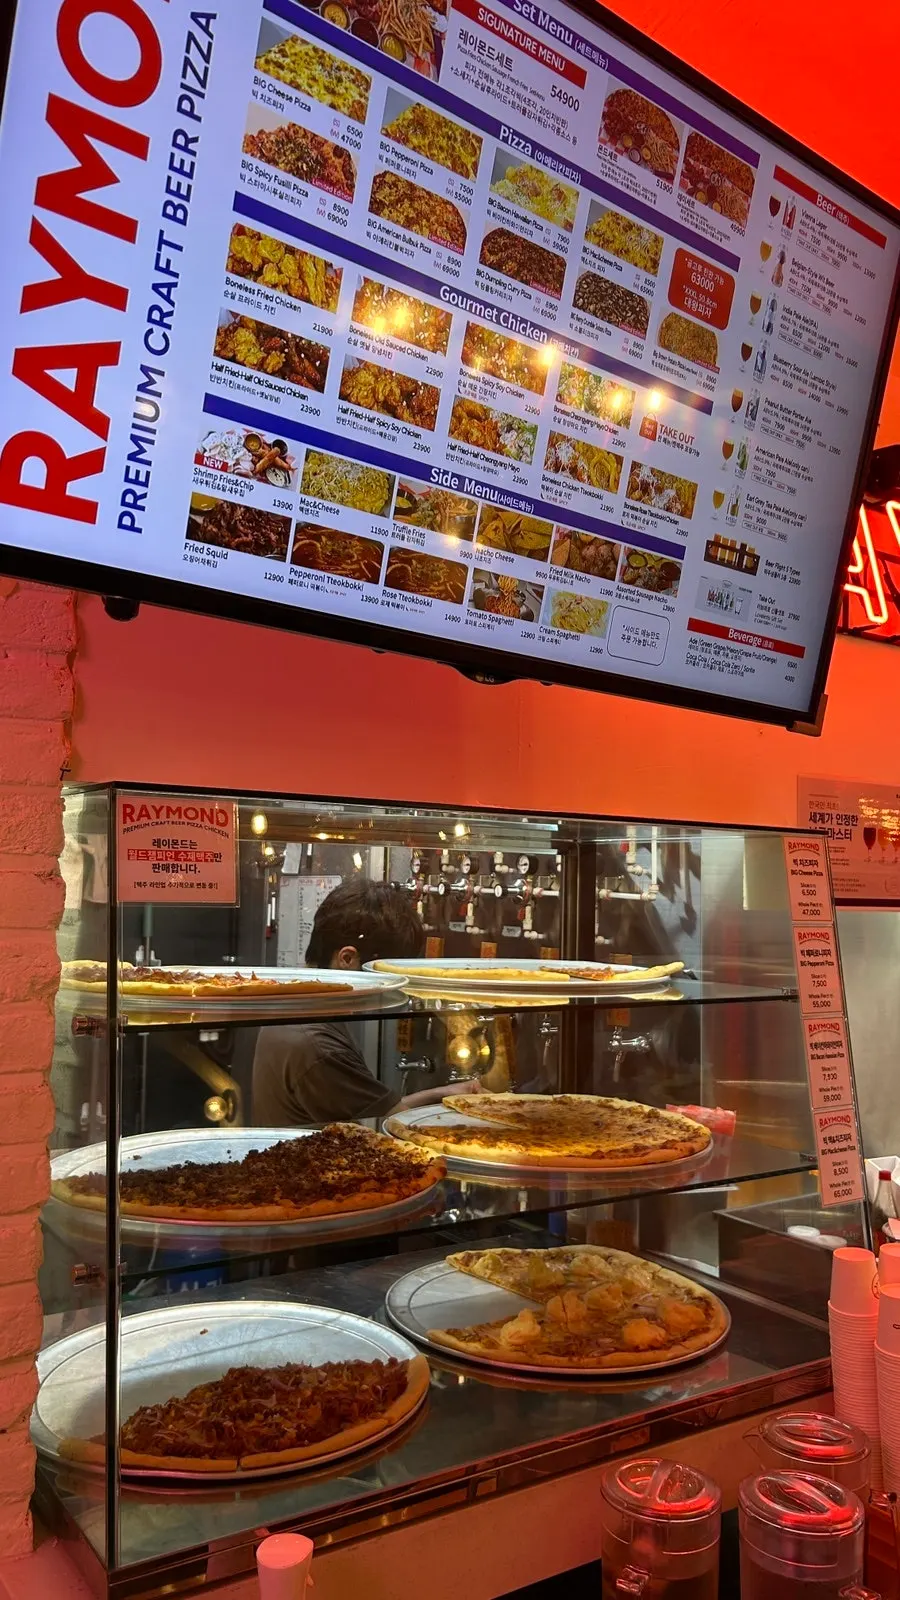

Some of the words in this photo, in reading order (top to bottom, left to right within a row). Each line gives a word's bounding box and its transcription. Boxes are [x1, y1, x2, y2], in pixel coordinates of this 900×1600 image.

[512, 0, 536, 22] Set
[537, 10, 573, 47] Menu
[477, 6, 537, 55] SIGUNATURE
[538, 45, 565, 73] MENU
[177, 10, 217, 122] PIZZA
[458, 27, 514, 73] 레이몬드세트
[549, 83, 580, 113] 54900
[252, 75, 267, 91] BIG
[267, 83, 293, 104] Cheese
[293, 96, 311, 114] Pizza
[346, 124, 363, 140] 6500
[499, 124, 533, 156] Pizza
[340, 133, 361, 151] 47000
[379, 140, 390, 153] BIG
[390, 146, 417, 169] Pepperoni
[418, 160, 433, 176] Pizza
[162, 127, 200, 229] BEER
[240, 159, 253, 173] BIG
[253, 165, 272, 183] Spicy
[272, 174, 291, 190] Fusilli
[291, 183, 308, 198] Pizza
[311, 177, 335, 194] Limited
[655, 178, 673, 195] 51900
[458, 182, 473, 196] 7500
[453, 191, 471, 206] 55000
[816, 193, 835, 215] Beer
[332, 202, 349, 217] 8900
[326, 211, 347, 228] 69000
[377, 222, 401, 240] American
[419, 241, 431, 254] Pizza
[729, 222, 745, 237] 49900
[0, 0, 170, 525] RAYMO
[446, 255, 461, 268] 8900
[442, 264, 459, 278] 69000
[691, 272, 715, 292] 63000
[143, 229, 184, 357] CRAFT
[223, 288, 236, 300] 순살
[237, 293, 262, 310] 프라이드
[263, 303, 276, 315] 치킨
[225, 276, 255, 295] Boneless
[256, 288, 273, 302] Fried
[274, 295, 301, 313] Chicken
[439, 284, 498, 322] Gourmet
[499, 309, 548, 344] Chicken
[312, 322, 333, 337] 21900
[348, 324, 374, 341] Boneless
[385, 339, 405, 353] Sauced
[406, 347, 428, 362] Chicken
[210, 361, 225, 373] Half
[425, 365, 443, 379] 22900
[481, 376, 495, 389] Spicy
[505, 386, 524, 399] Chicken
[299, 403, 320, 417] 23900
[337, 404, 349, 415] Half
[375, 417, 390, 430] Spicy
[659, 424, 679, 440] TAKE
[679, 432, 696, 446] OUT
[117, 365, 165, 535] PREMIUM
[413, 441, 431, 453] 23900
[202, 456, 223, 469] NEW
[193, 467, 218, 482] Shrimp
[218, 474, 254, 491] Fries&Chip
[429, 466, 459, 489] Side
[512, 475, 528, 486] 23900
[541, 474, 561, 486] Boneless
[561, 481, 579, 492] Chicken
[272, 498, 293, 511] 13900
[299, 497, 340, 515] Mac&Cheese
[370, 525, 388, 537] 11900
[392, 523, 411, 535] Truffle
[183, 542, 204, 554] Fried
[205, 547, 228, 561] Squid
[494, 551, 514, 563] Cheese
[263, 571, 284, 583] 12900
[289, 567, 325, 583] Pepperoni
[326, 575, 363, 591] Tteokbokki
[381, 589, 400, 600] Rose
[466, 609, 487, 620] Tomato
[487, 614, 514, 627] Spaghetti
[556, 630, 580, 642] Spaghetti
[727, 628, 761, 647] Beverage
[122, 803, 229, 828] RAYMOND
[808, 811, 833, 825] 세계가
[835, 814, 859, 827] 인정한
[122, 822, 151, 835] PREMIUM
[186, 821, 203, 829] PIZZA
[204, 825, 230, 839] CHICKEN
[152, 838, 198, 850] 레이몬드는
[788, 841, 820, 852] RAYMOND
[151, 863, 201, 874] 판매합니다.
[801, 889, 817, 897] 6,500
[798, 932, 830, 941] RAYMOND
[813, 1000, 831, 1008] 55,000
[808, 1023, 840, 1033] RAYMOND
[819, 1115, 851, 1128] RAYMOND
[834, 1188, 853, 1199] 65,000
